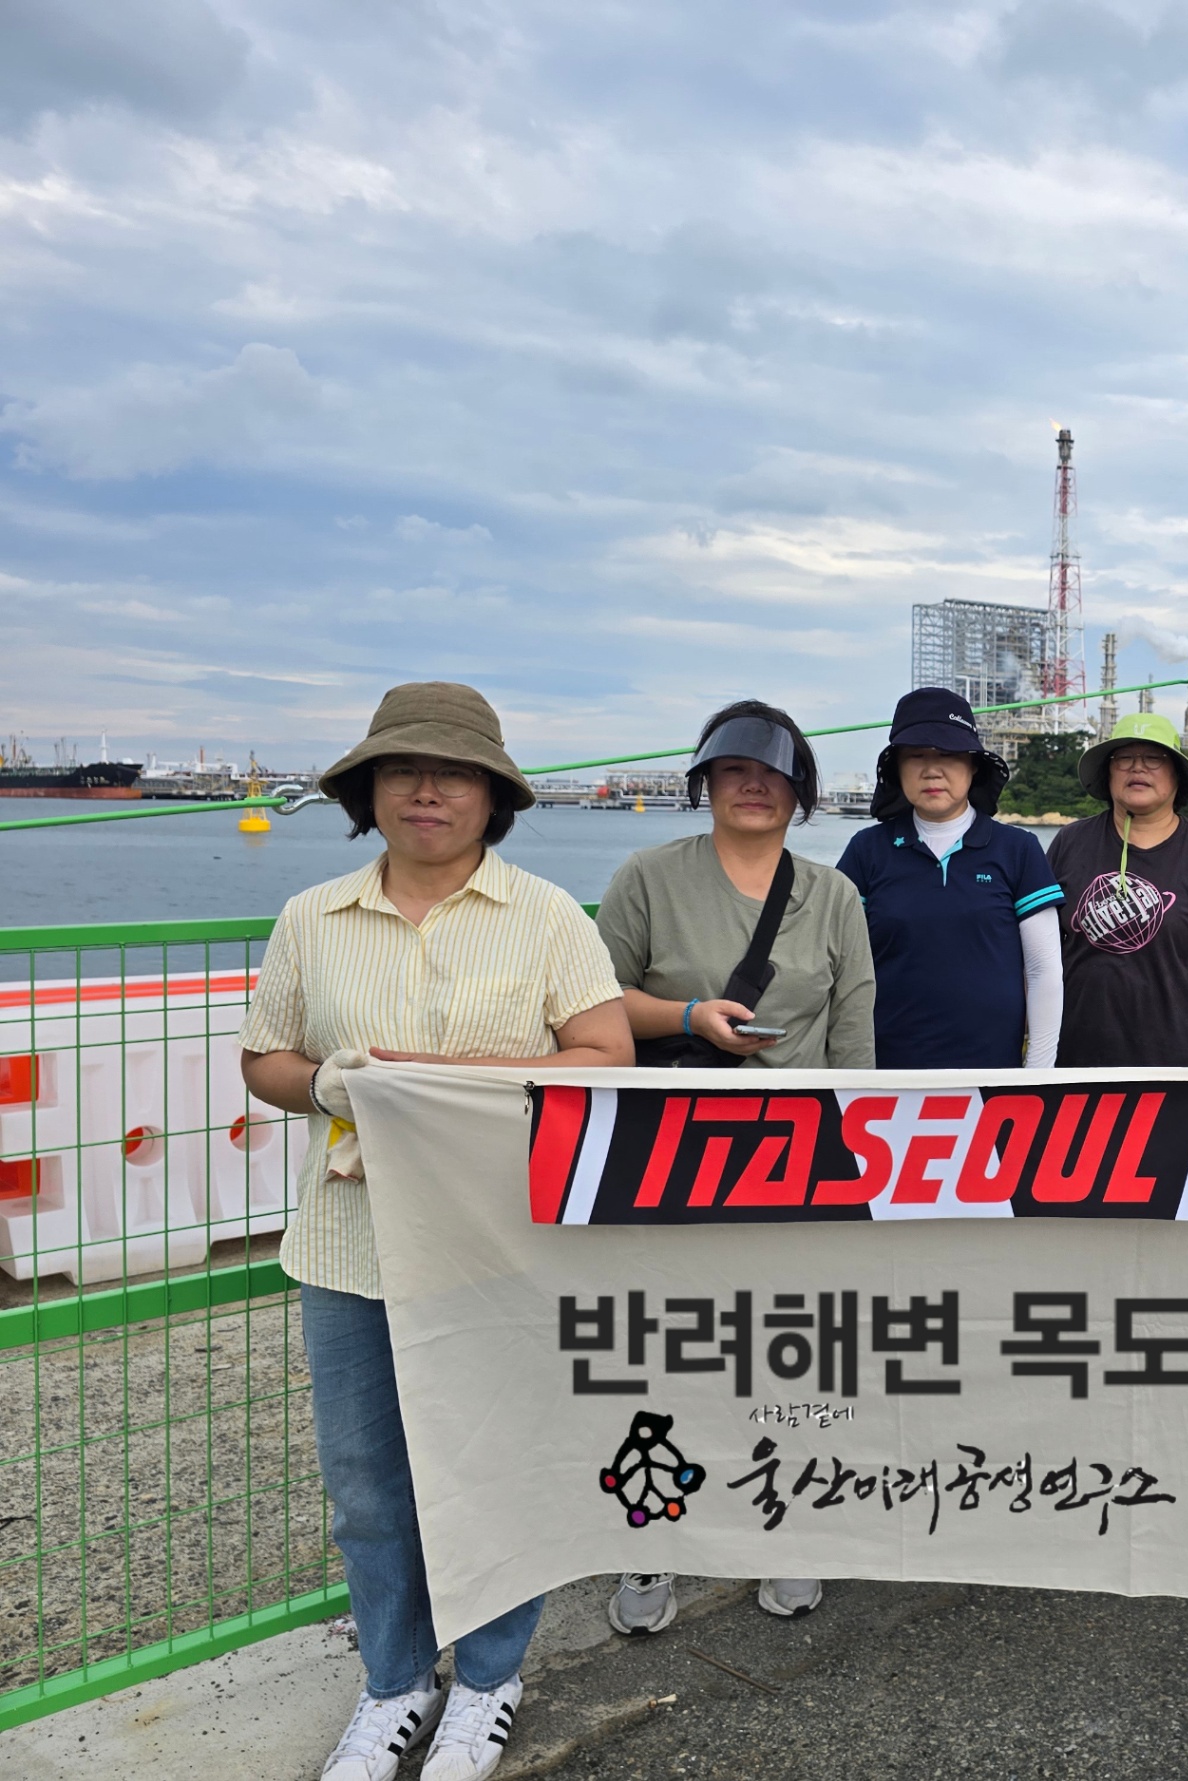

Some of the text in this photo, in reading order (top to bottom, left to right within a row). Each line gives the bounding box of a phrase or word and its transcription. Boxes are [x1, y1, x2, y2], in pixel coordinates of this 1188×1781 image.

[633, 1092, 1166, 1208] ITASEOUL
[558, 1290, 961, 1398] 반려해변
[749, 1403, 854, 1429] 사람곁에
